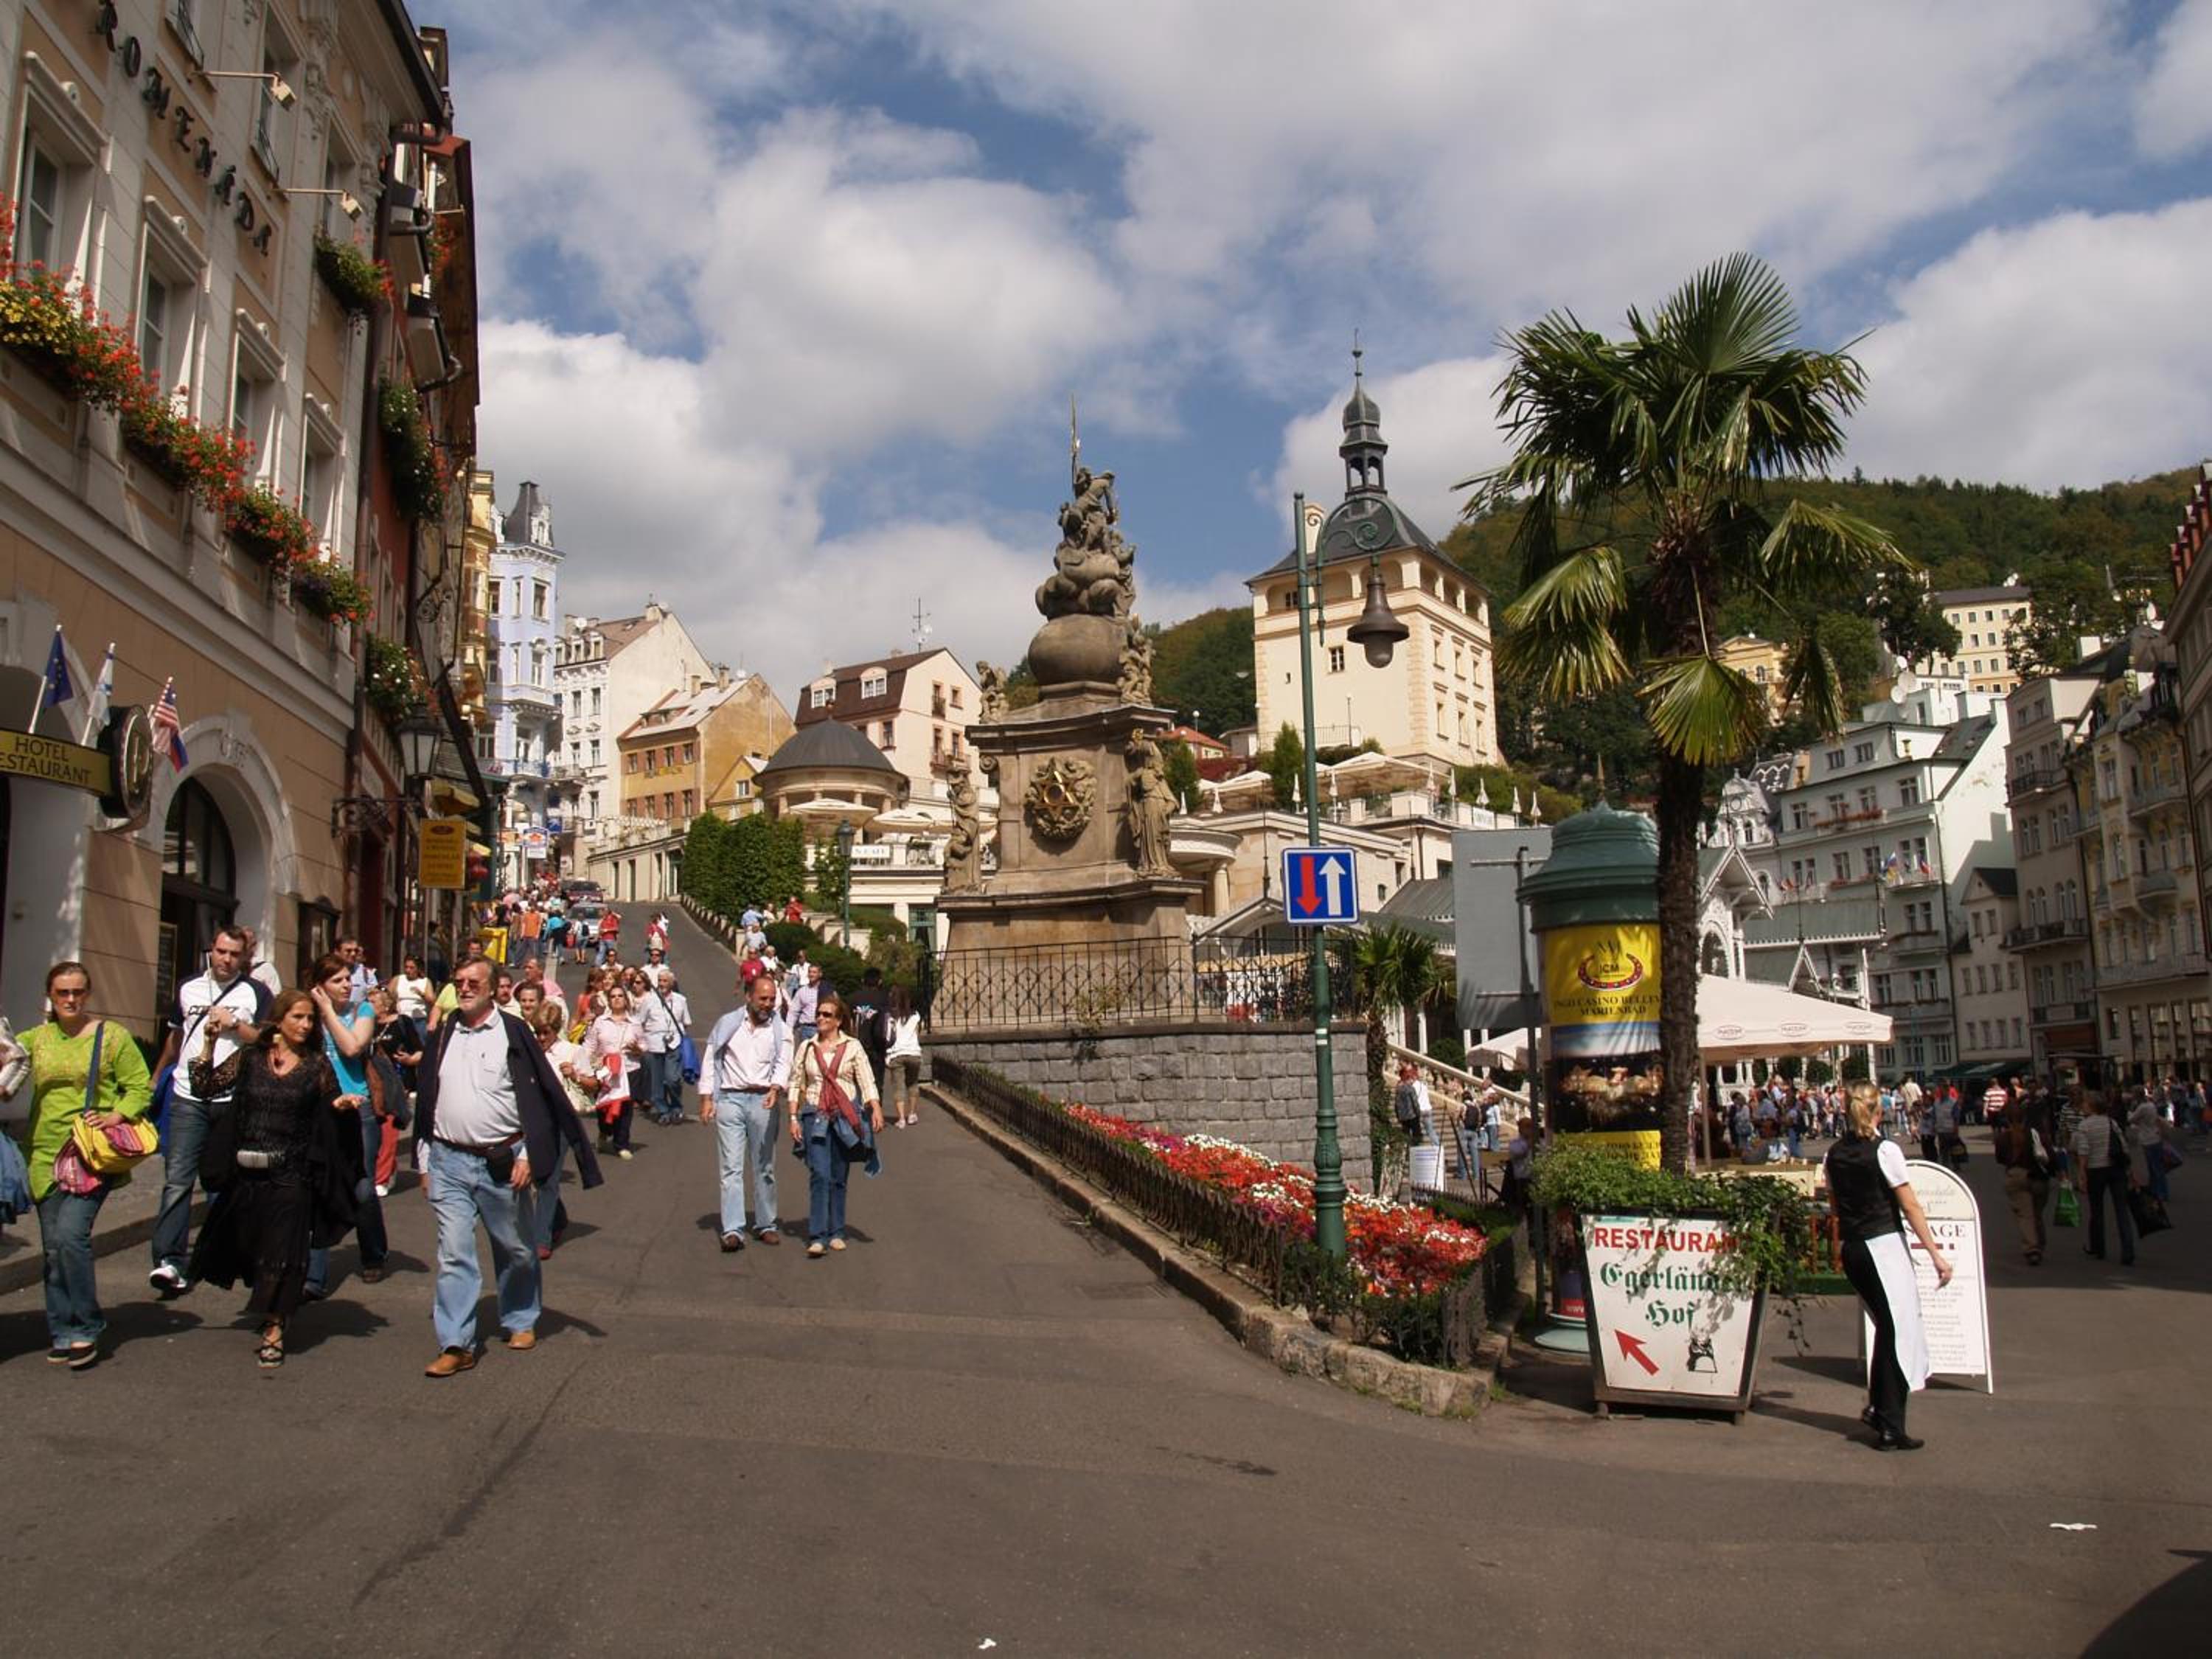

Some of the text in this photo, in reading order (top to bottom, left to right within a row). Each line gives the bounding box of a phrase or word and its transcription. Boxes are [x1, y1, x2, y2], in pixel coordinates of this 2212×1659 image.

[15, 736, 69, 762] HOTEL
[1577, 996, 1618, 1006] CASINO
[1594, 1226, 1750, 1253] RESTAURAN
[1645, 1299, 1695, 1330] Hof
